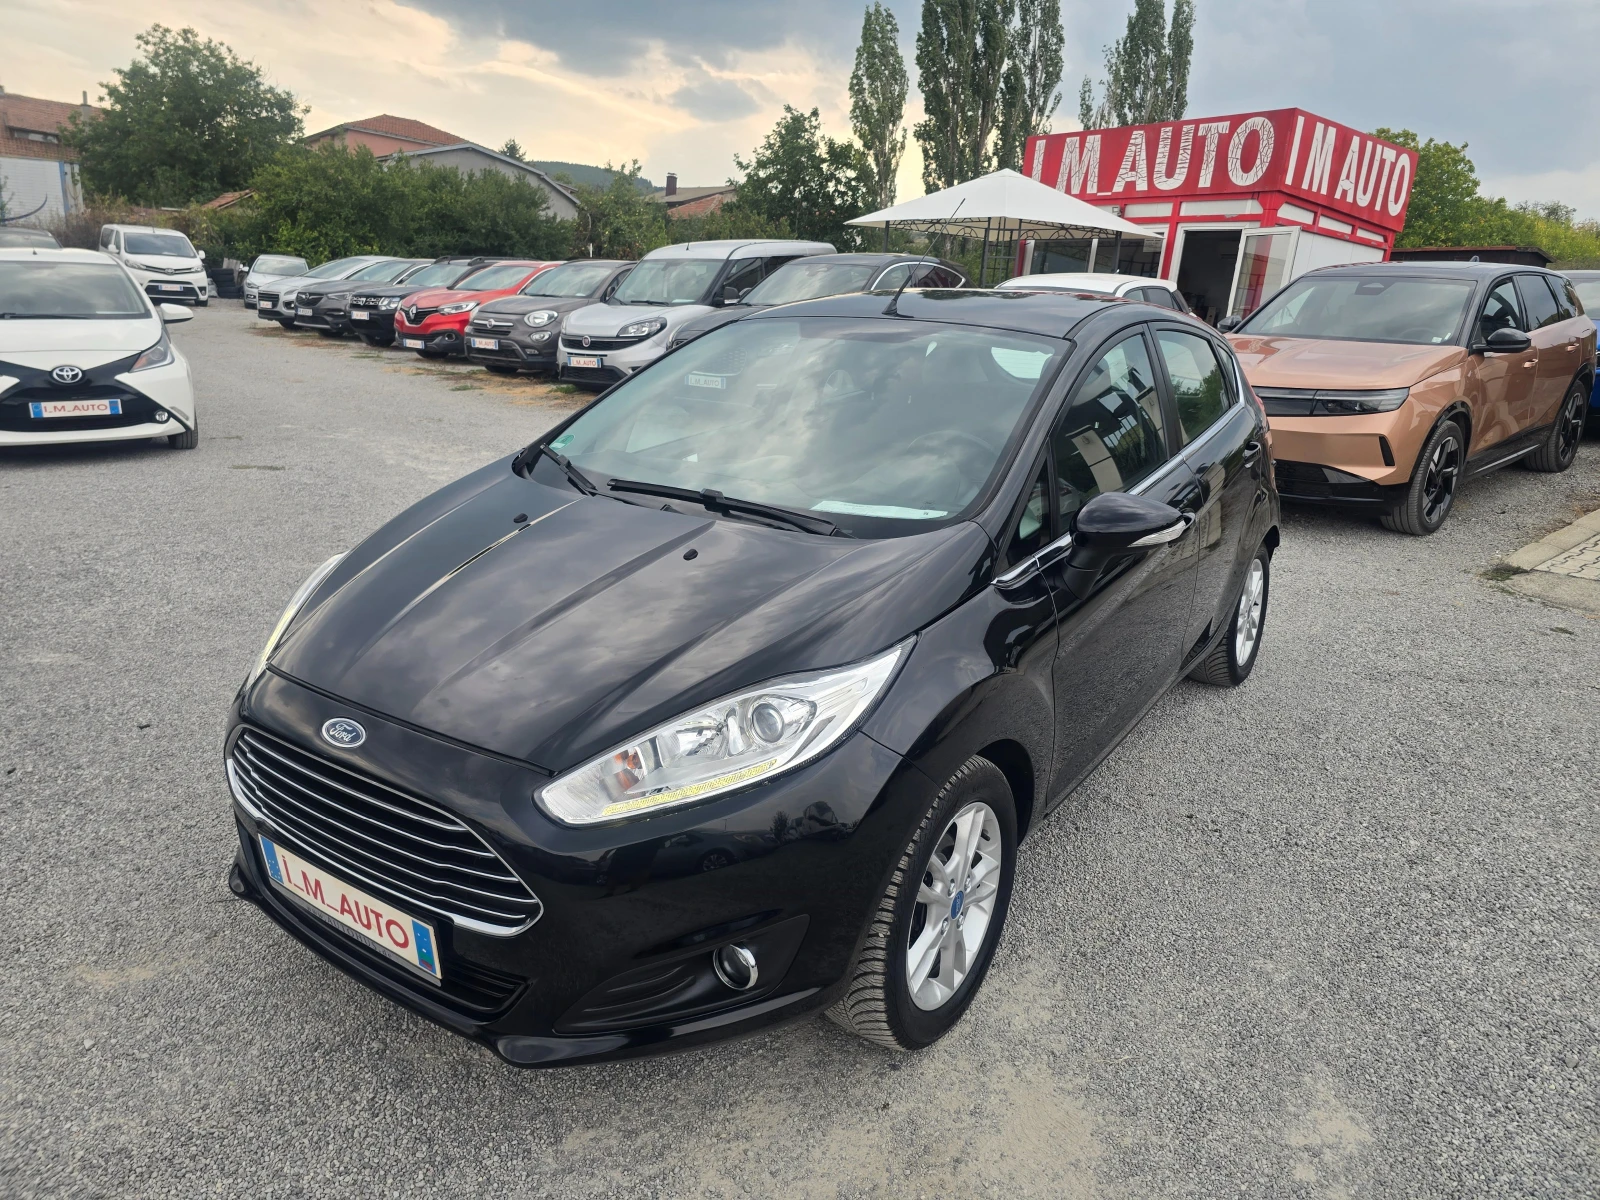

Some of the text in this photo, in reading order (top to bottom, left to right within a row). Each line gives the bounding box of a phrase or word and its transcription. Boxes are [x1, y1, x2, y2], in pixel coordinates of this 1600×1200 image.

[1302, 122, 1338, 196] M
[1335, 135, 1411, 217] AUTO
[43, 403, 109, 414] I_M_AUTO
[330, 722, 357, 742] Ford
